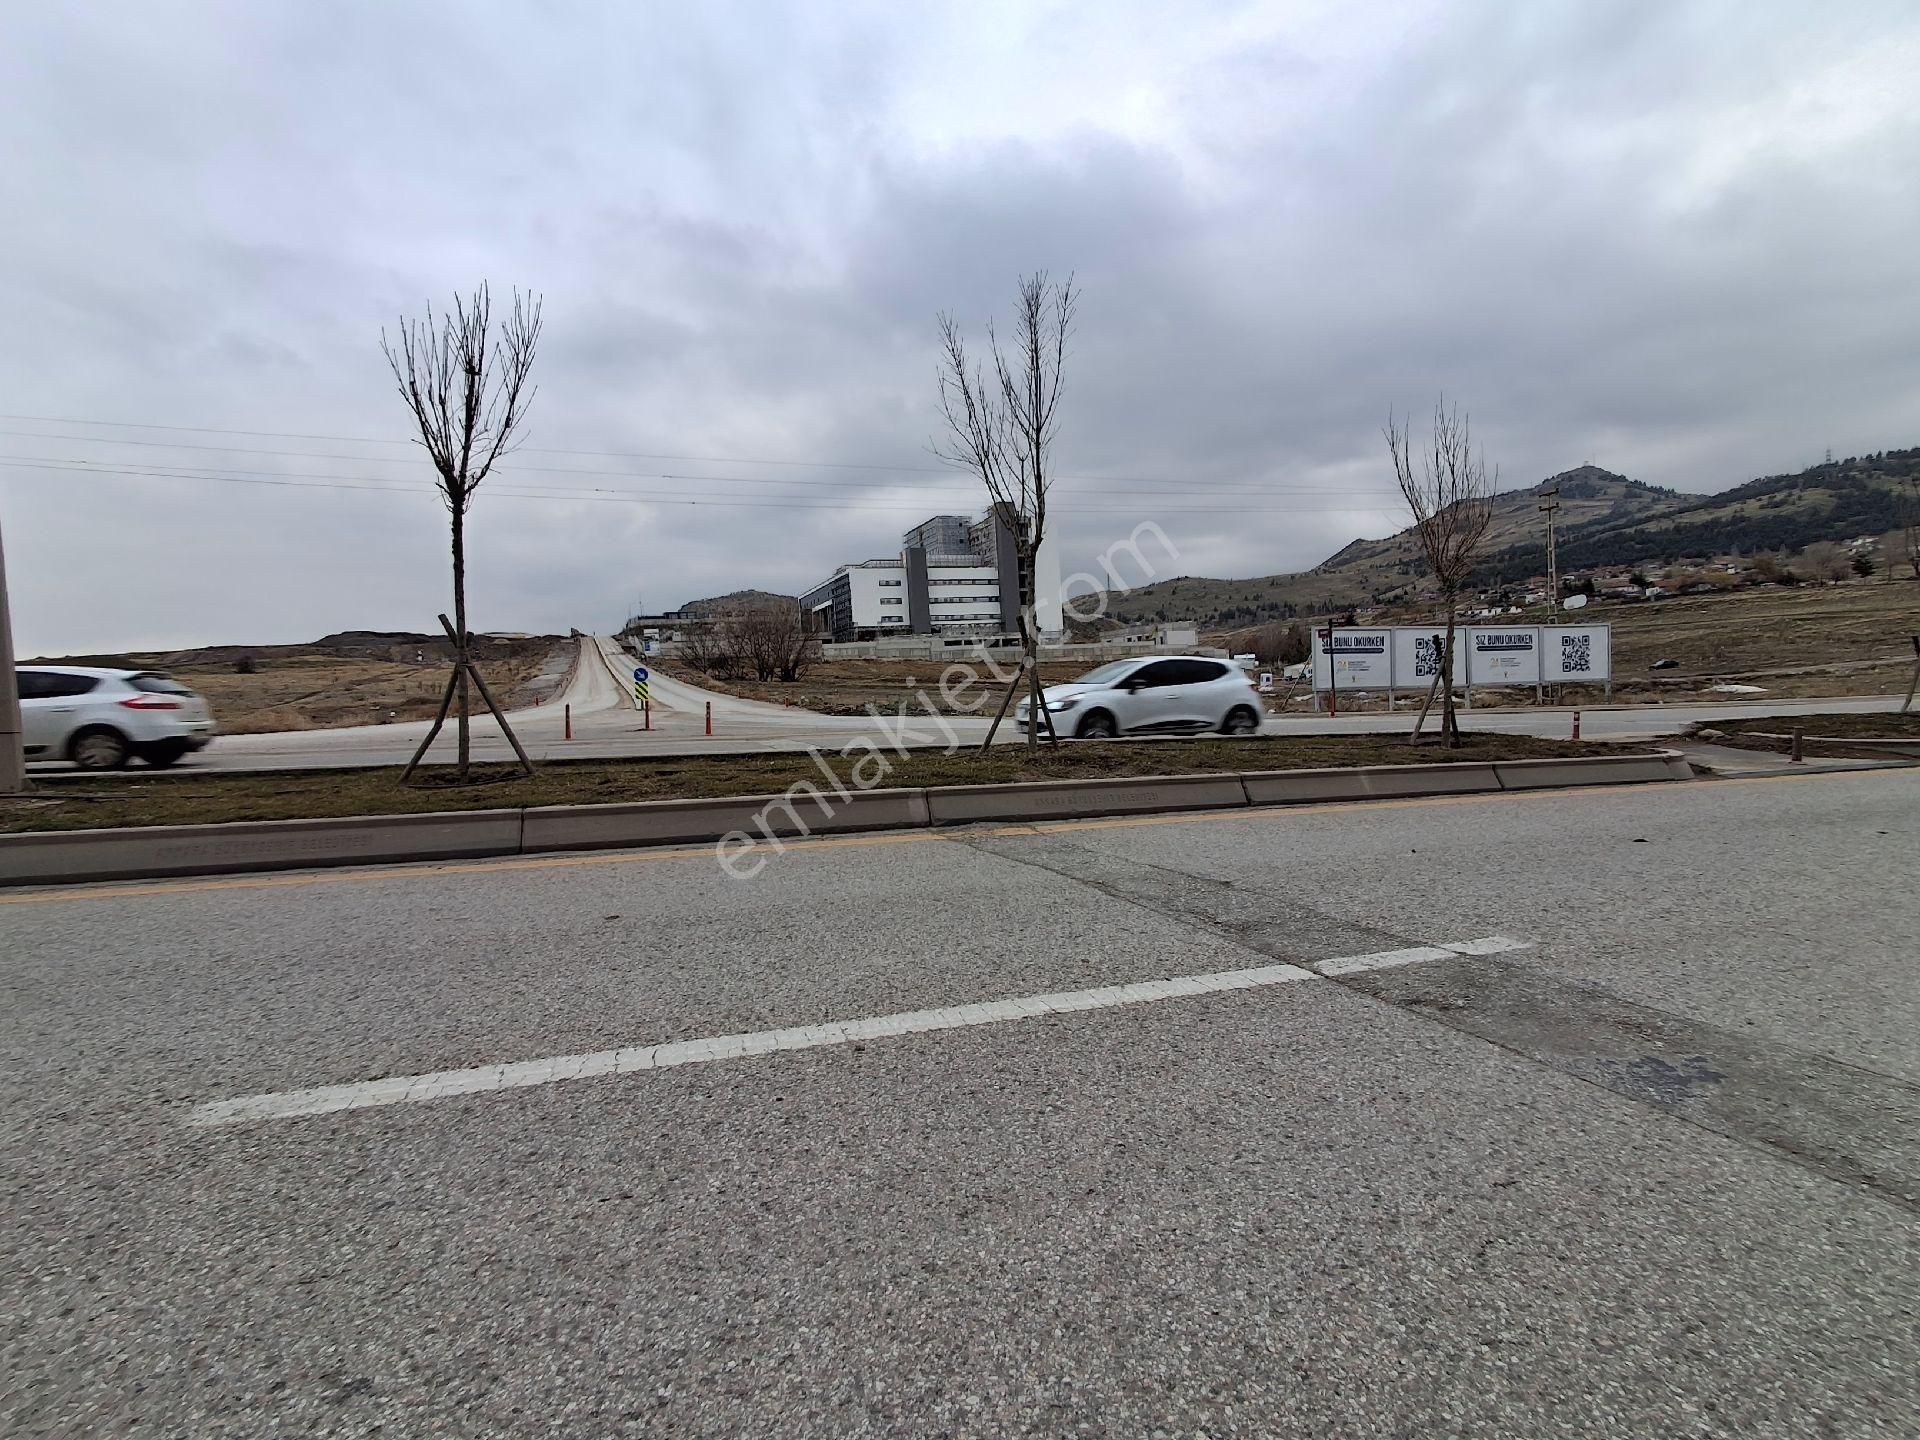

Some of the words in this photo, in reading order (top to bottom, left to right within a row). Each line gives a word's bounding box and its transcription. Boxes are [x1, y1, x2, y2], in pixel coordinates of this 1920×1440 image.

[1334, 636, 1353, 648] BUNU
[1354, 636, 1385, 647] OKURKEN
[1487, 635, 1504, 645] BUNU
[1505, 634, 1533, 645] OKURKEN
